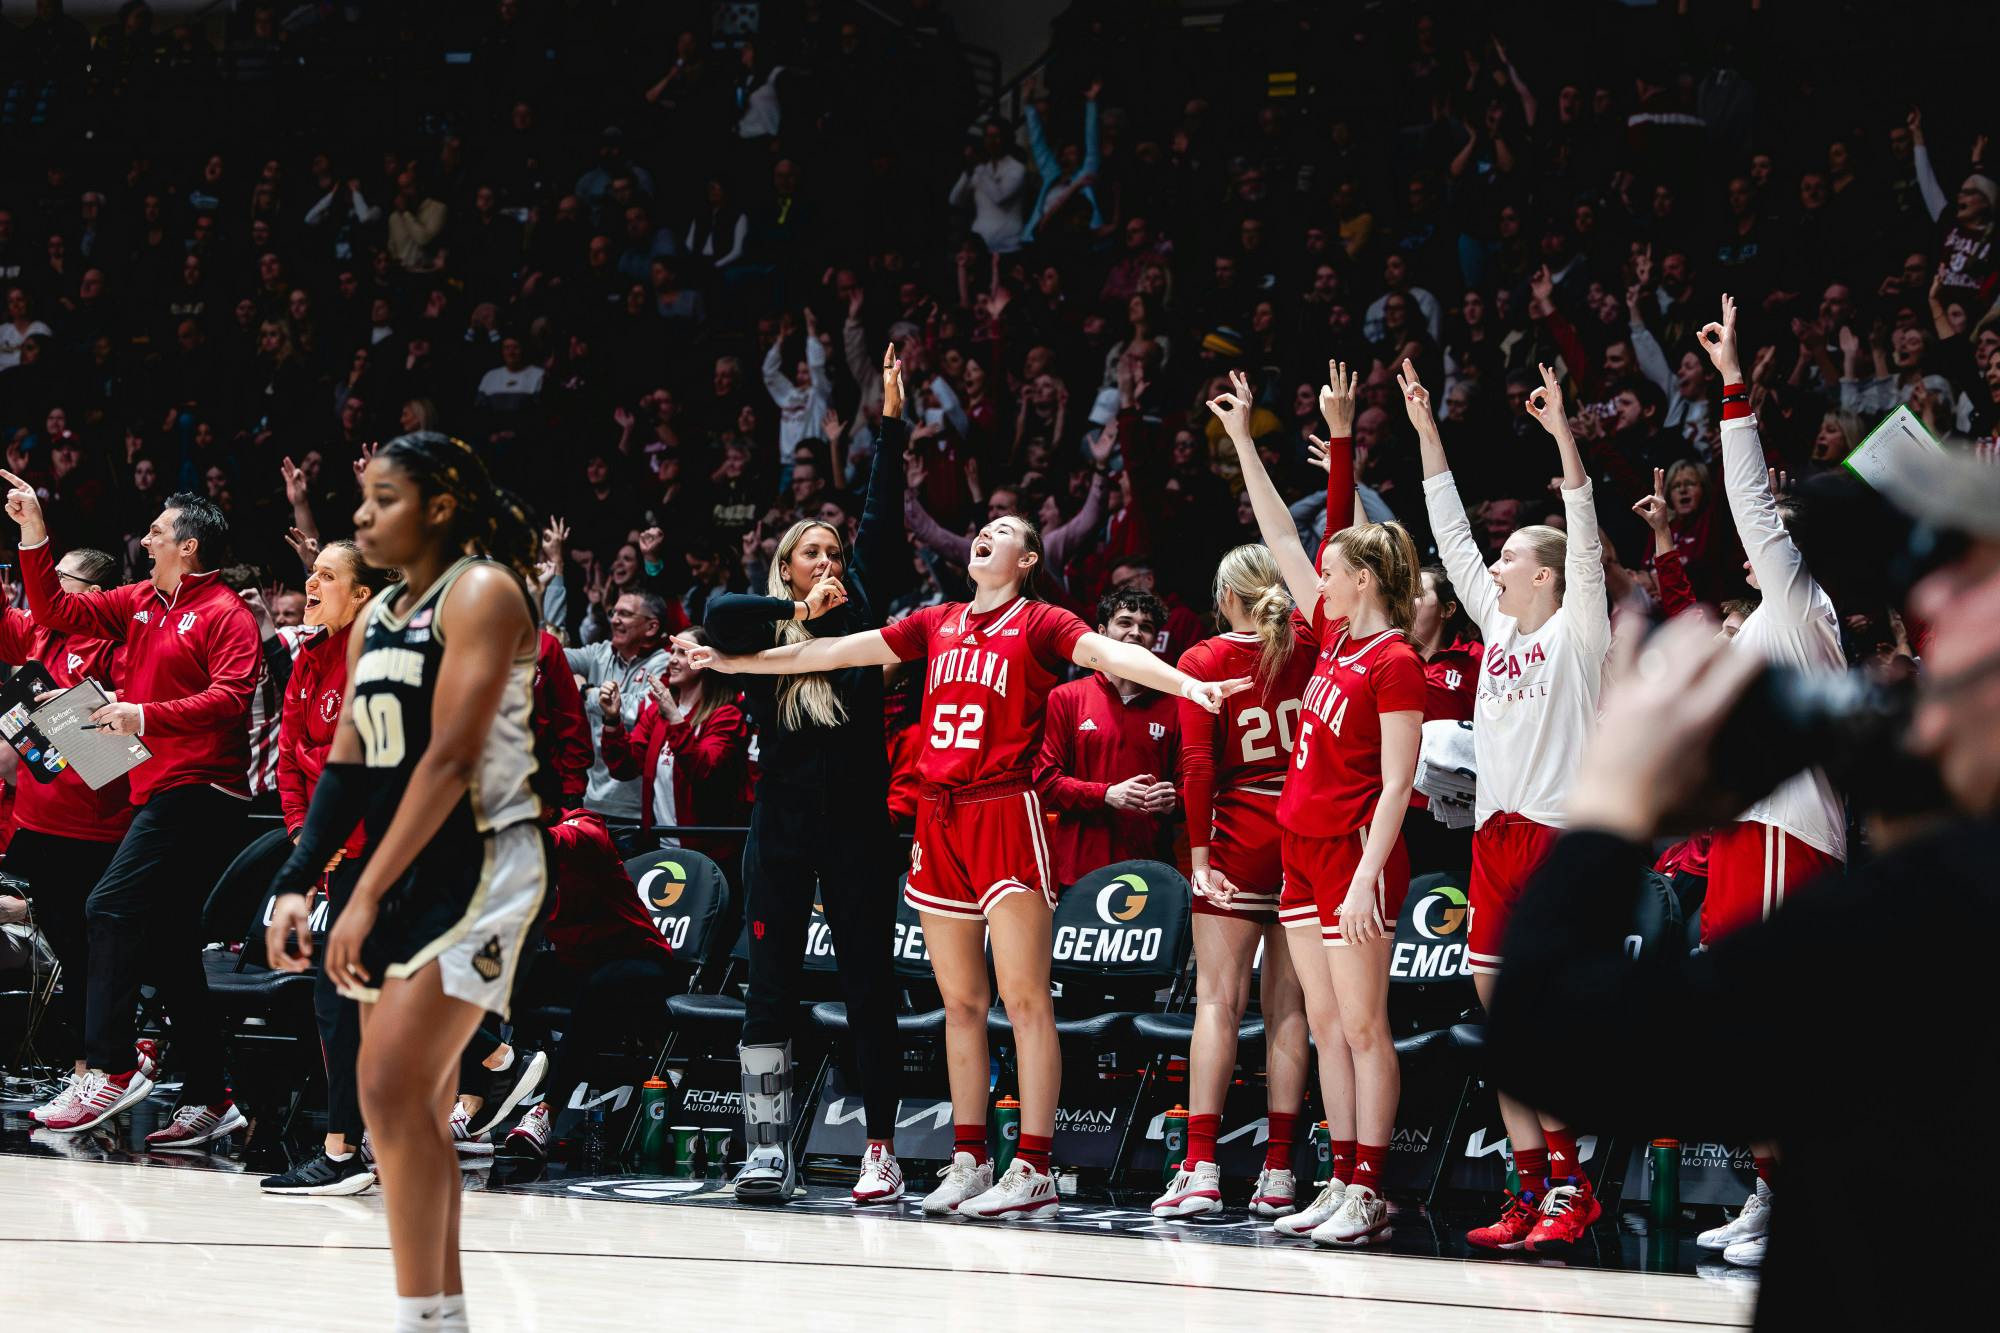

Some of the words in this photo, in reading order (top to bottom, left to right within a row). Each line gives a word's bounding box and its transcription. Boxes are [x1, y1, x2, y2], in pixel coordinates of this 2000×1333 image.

[929, 647, 1009, 698] INDIANA
[352, 692, 406, 768] 10
[930, 704, 985, 750] 52
[1237, 697, 1302, 763] 20
[1296, 721, 1313, 771] 5
[1052, 926, 1162, 962] GEMCO
[682, 1089, 743, 1105] ROHR
[1055, 1107, 1117, 1124] RMAN
[1072, 1123, 1111, 1133] GROUP
[1681, 1157, 1728, 1168] MOTIVE
